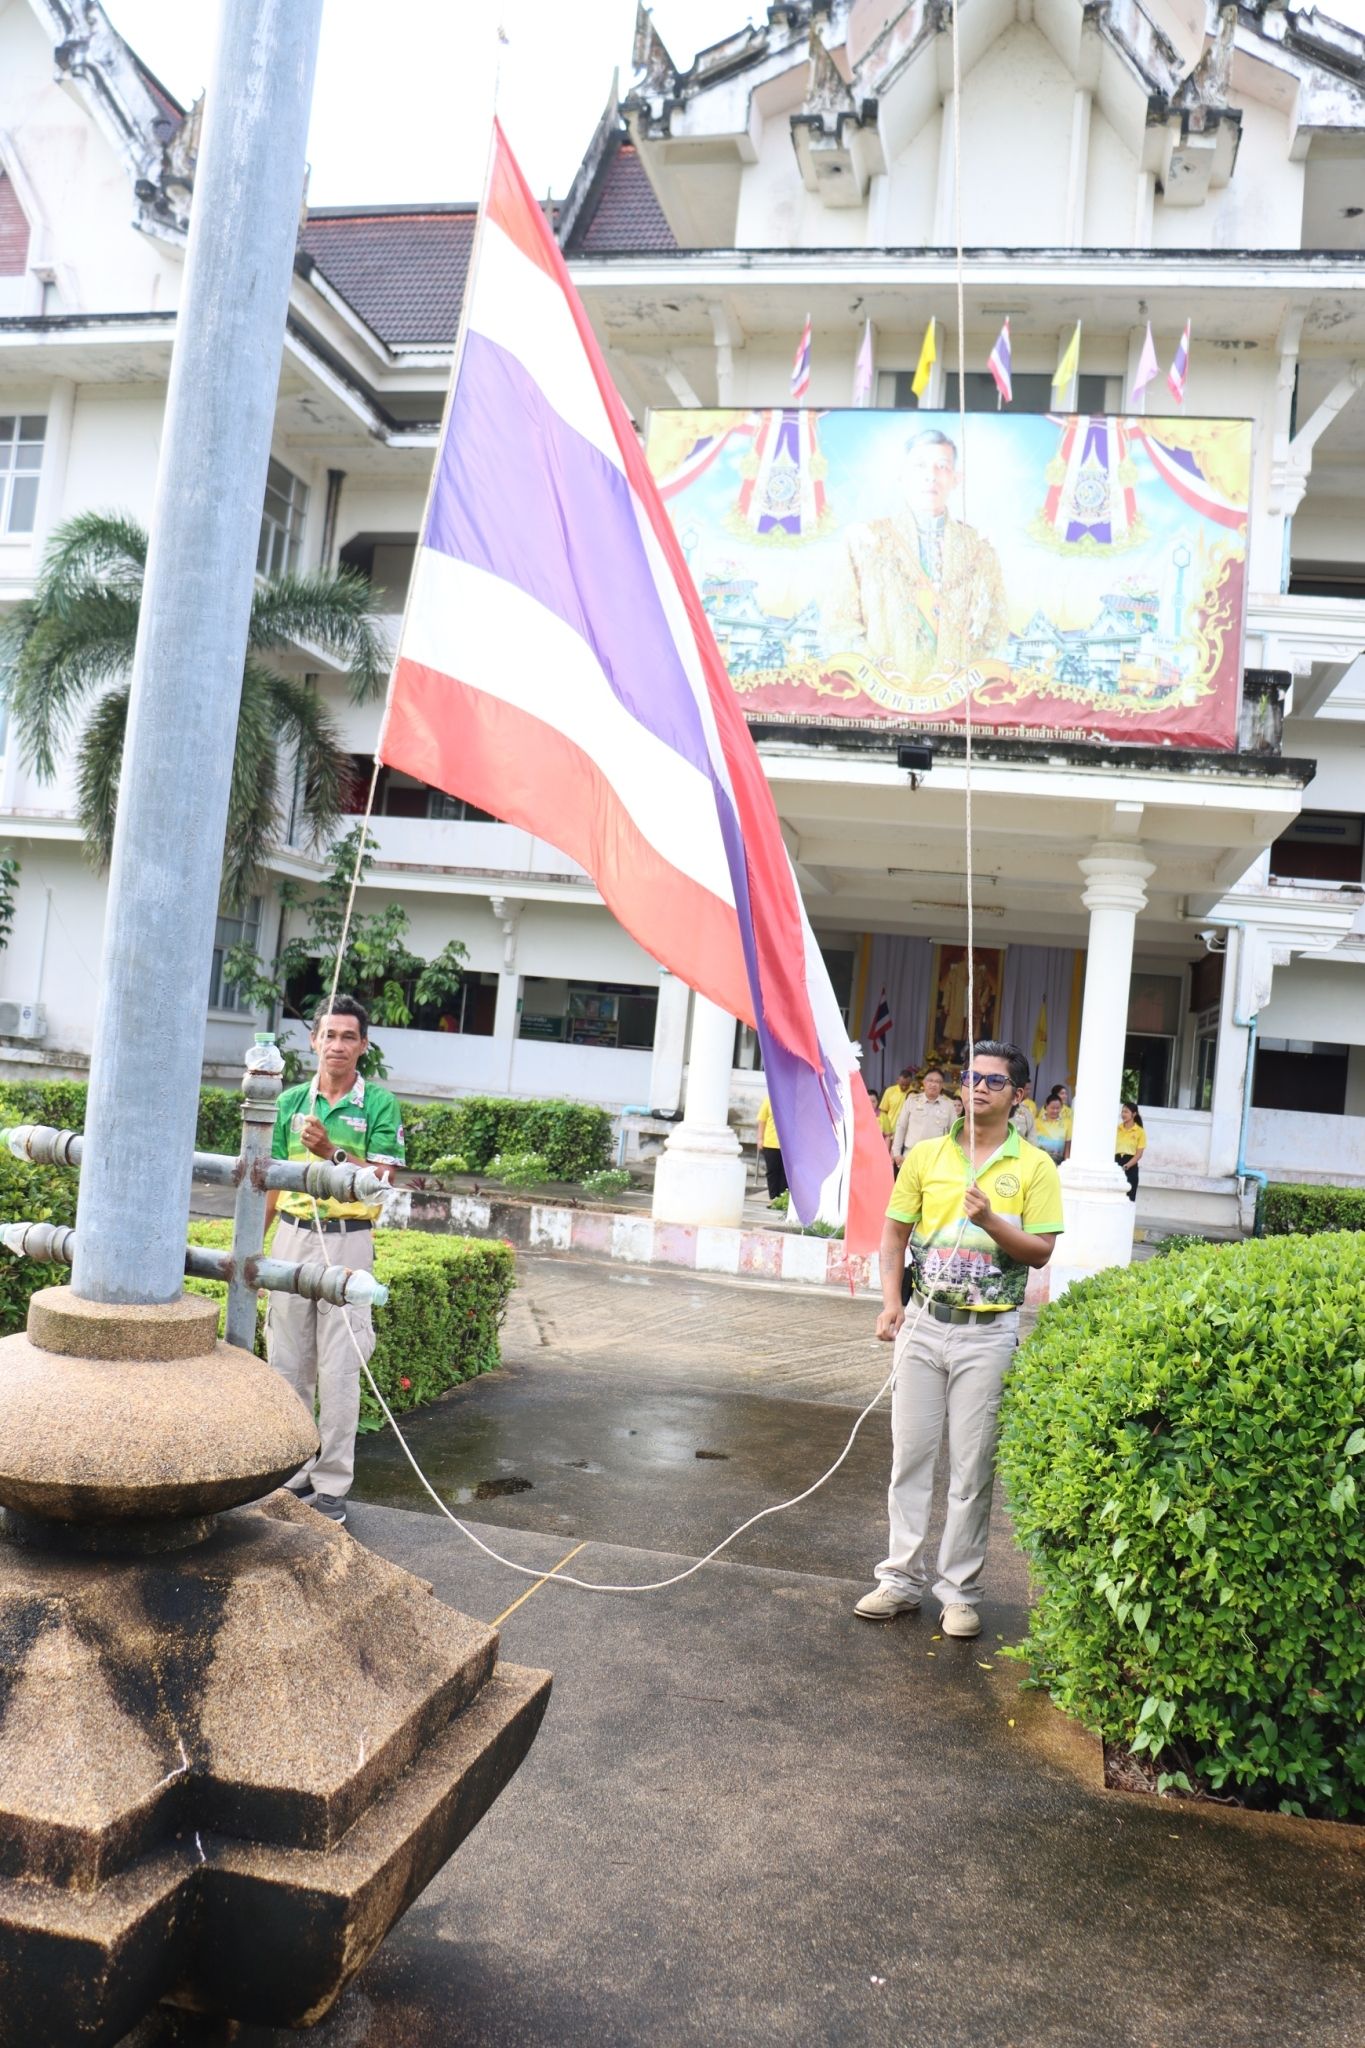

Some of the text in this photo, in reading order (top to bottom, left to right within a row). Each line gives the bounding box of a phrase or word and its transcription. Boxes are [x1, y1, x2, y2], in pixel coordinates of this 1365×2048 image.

[858, 664, 984, 711] ทรงพระเจริญ
